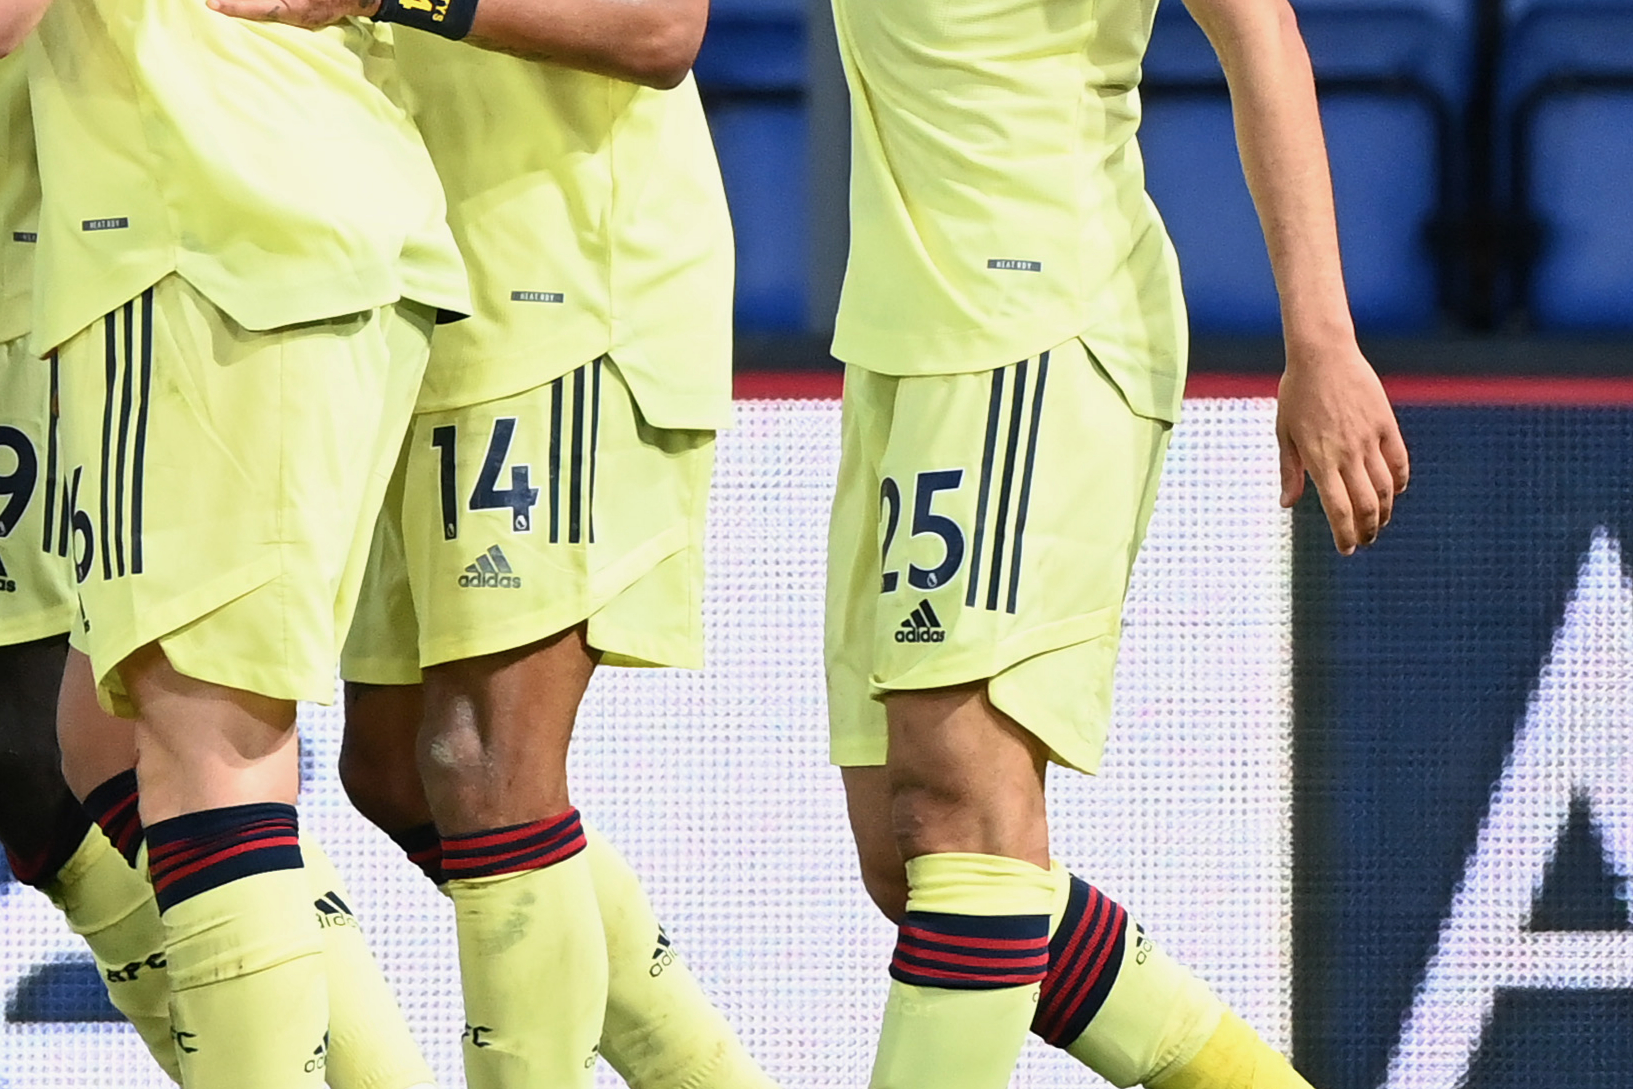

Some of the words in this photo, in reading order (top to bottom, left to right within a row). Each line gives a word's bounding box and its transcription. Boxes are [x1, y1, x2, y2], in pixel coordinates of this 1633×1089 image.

[71, 465, 95, 585] 6
[430, 417, 541, 542] 14
[879, 468, 967, 594] 25
[457, 571, 522, 589] adidas
[894, 626, 946, 643] adidas
